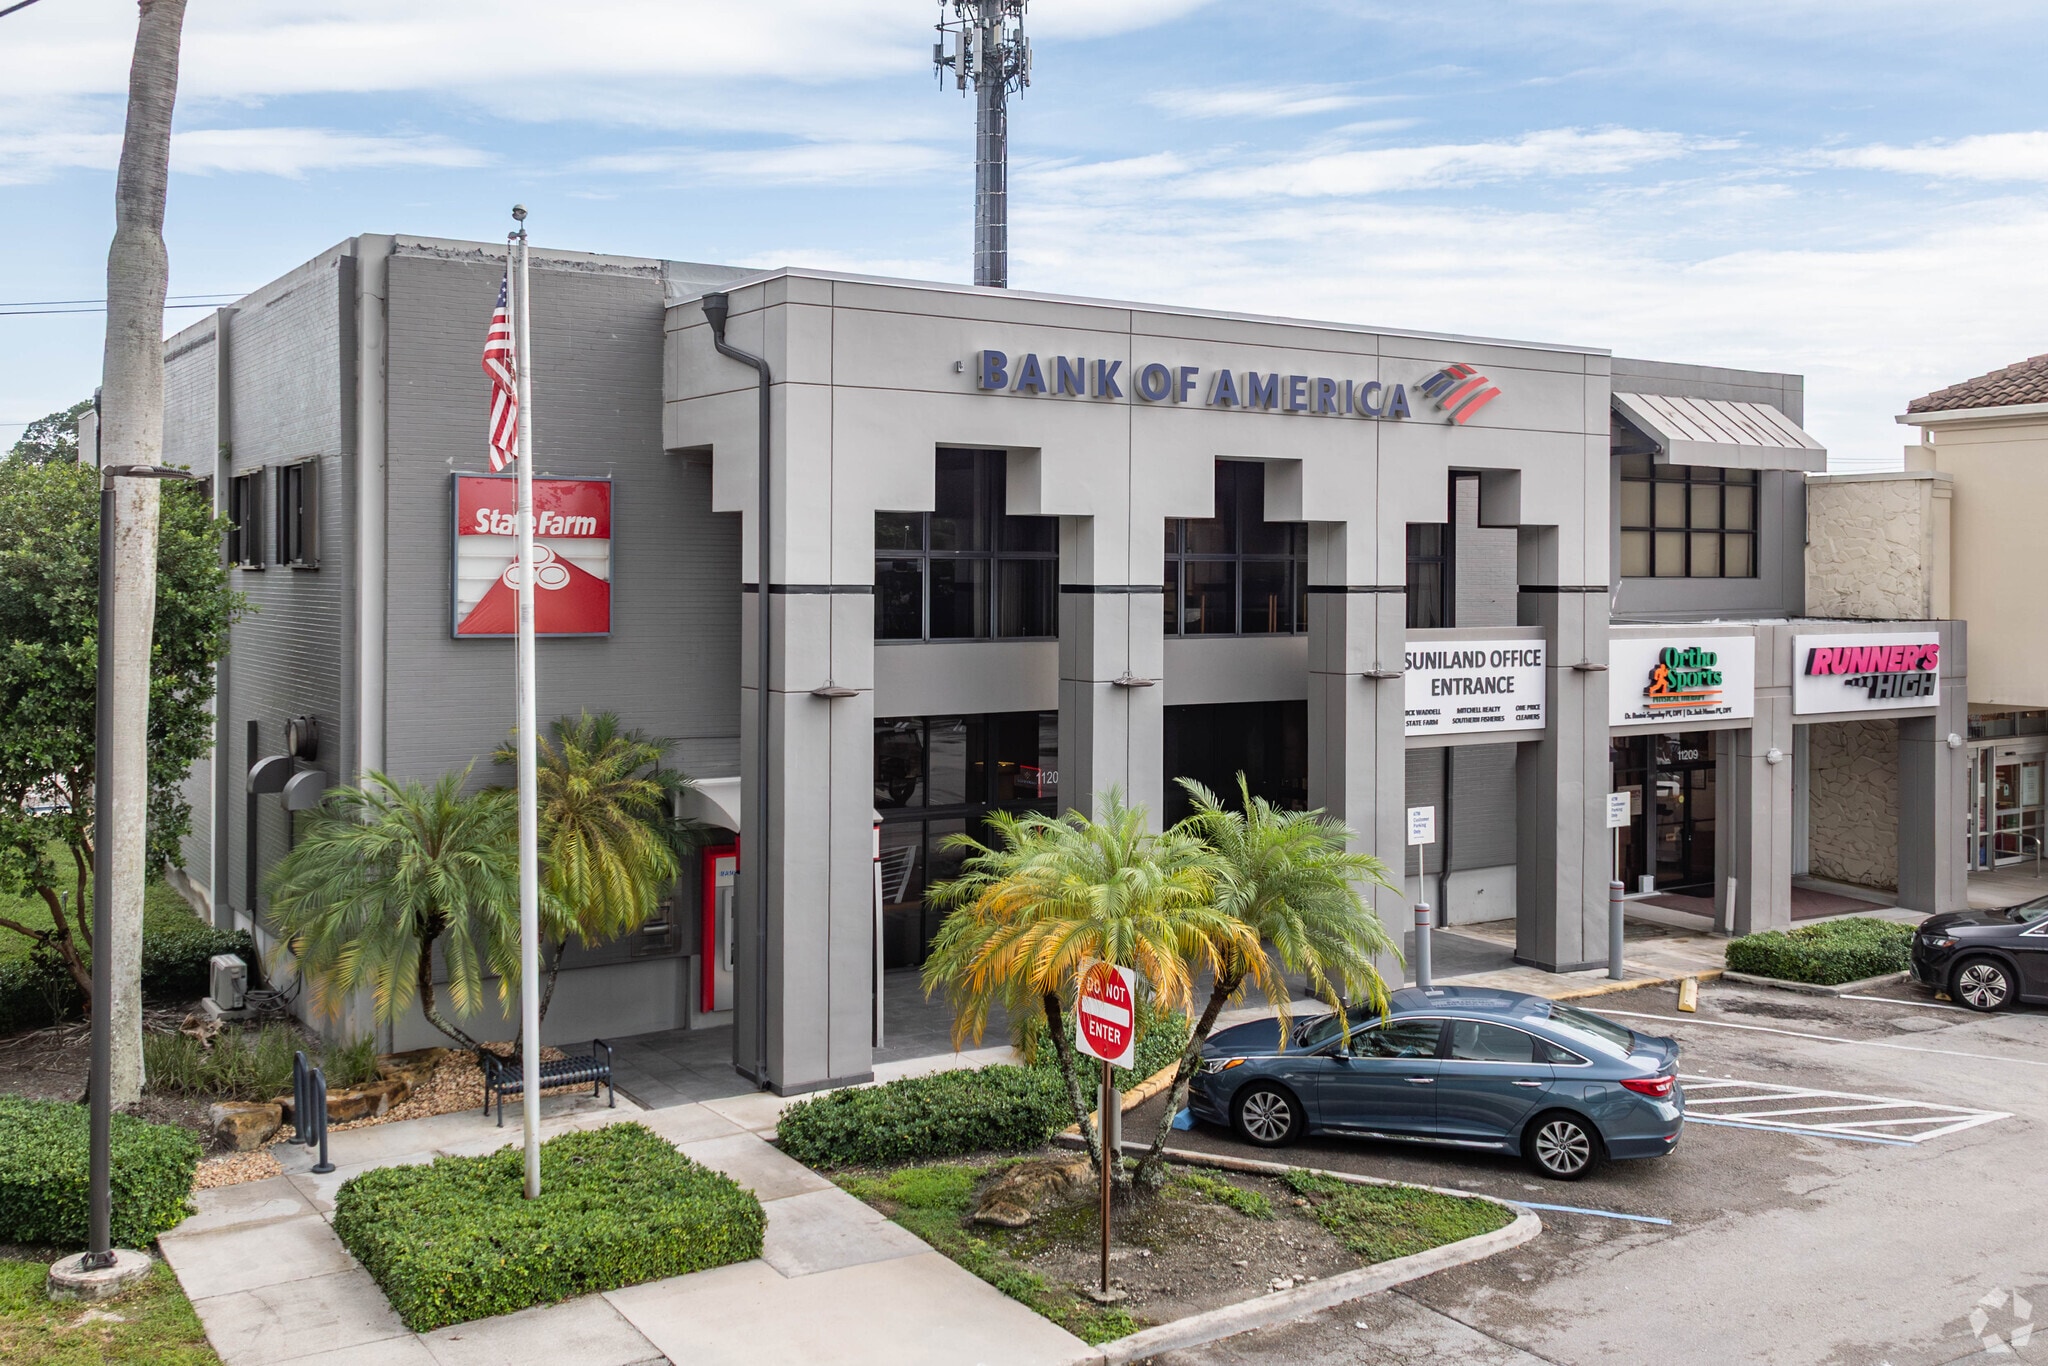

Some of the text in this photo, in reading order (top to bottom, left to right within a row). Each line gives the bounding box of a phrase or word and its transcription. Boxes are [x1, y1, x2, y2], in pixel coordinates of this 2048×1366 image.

[979, 350, 1411, 418] BANK OF AMERICA
[539, 511, 597, 535] Farm
[1405, 649, 1541, 670] SUNILAND OFFICE
[1662, 647, 1718, 668] Ortho
[1807, 644, 1940, 675] RUNNER'S
[1431, 676, 1515, 696] ENTRANCE
[1667, 669, 1722, 692] Sports
[1871, 673, 1936, 698] HIGH
[1405, 719, 1422, 727] STATE
[1416, 708, 1441, 716] WADDELL
[1480, 715, 1505, 723] FISHERIES
[1677, 749, 1699, 760] 11209
[1086, 977, 1125, 1002] DO NOT
[1089, 1021, 1120, 1045] ENTER
